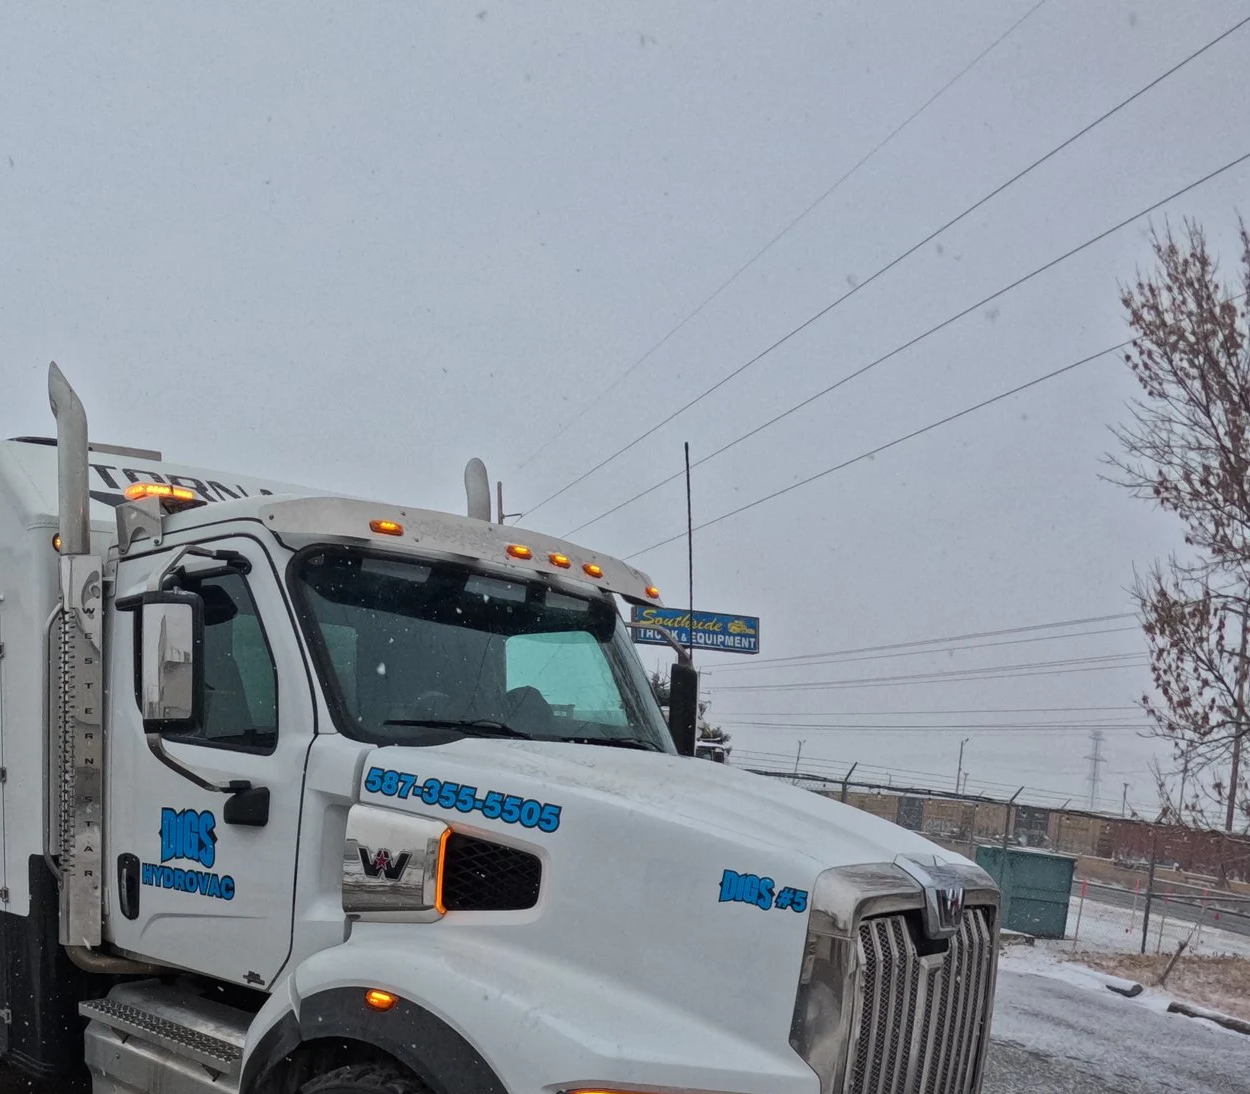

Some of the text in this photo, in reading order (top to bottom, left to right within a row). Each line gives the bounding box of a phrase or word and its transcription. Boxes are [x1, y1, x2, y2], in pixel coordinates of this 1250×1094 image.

[640, 609, 723, 632] Southside
[681, 633, 688, 642] &
[691, 632, 756, 649] EQUIPMENT
[82, 607, 95, 877] WESTERN STAR
[365, 766, 562, 833] 587-355-5505
[158, 807, 218, 869] DIGS
[142, 862, 235, 901] HYDROVAC
[718, 869, 808, 913] DIGS #5
